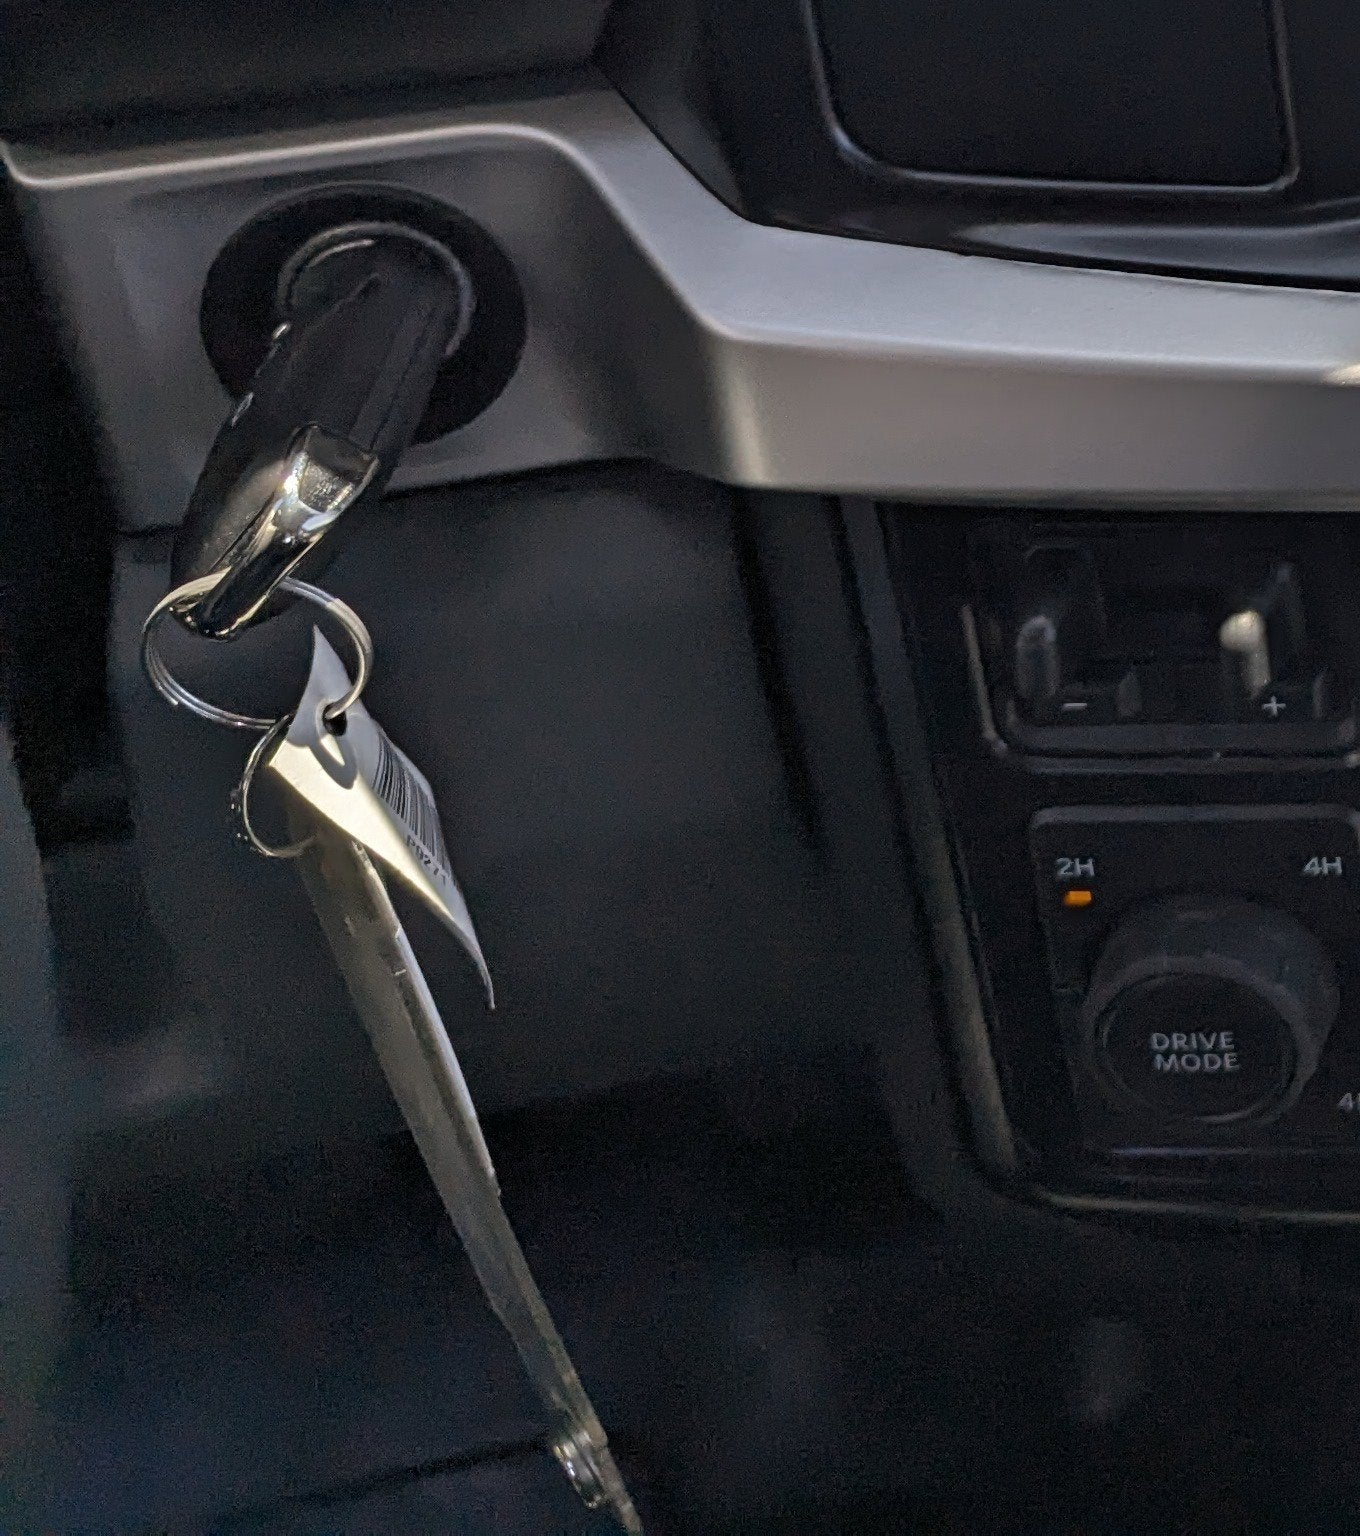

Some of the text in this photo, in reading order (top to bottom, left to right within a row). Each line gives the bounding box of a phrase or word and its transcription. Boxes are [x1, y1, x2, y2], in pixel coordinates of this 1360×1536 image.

[1056, 857, 1096, 878] 2H
[1302, 856, 1343, 876] 4H
[1150, 1031, 1236, 1052] DRIVE
[1153, 1052, 1240, 1073] MODE
